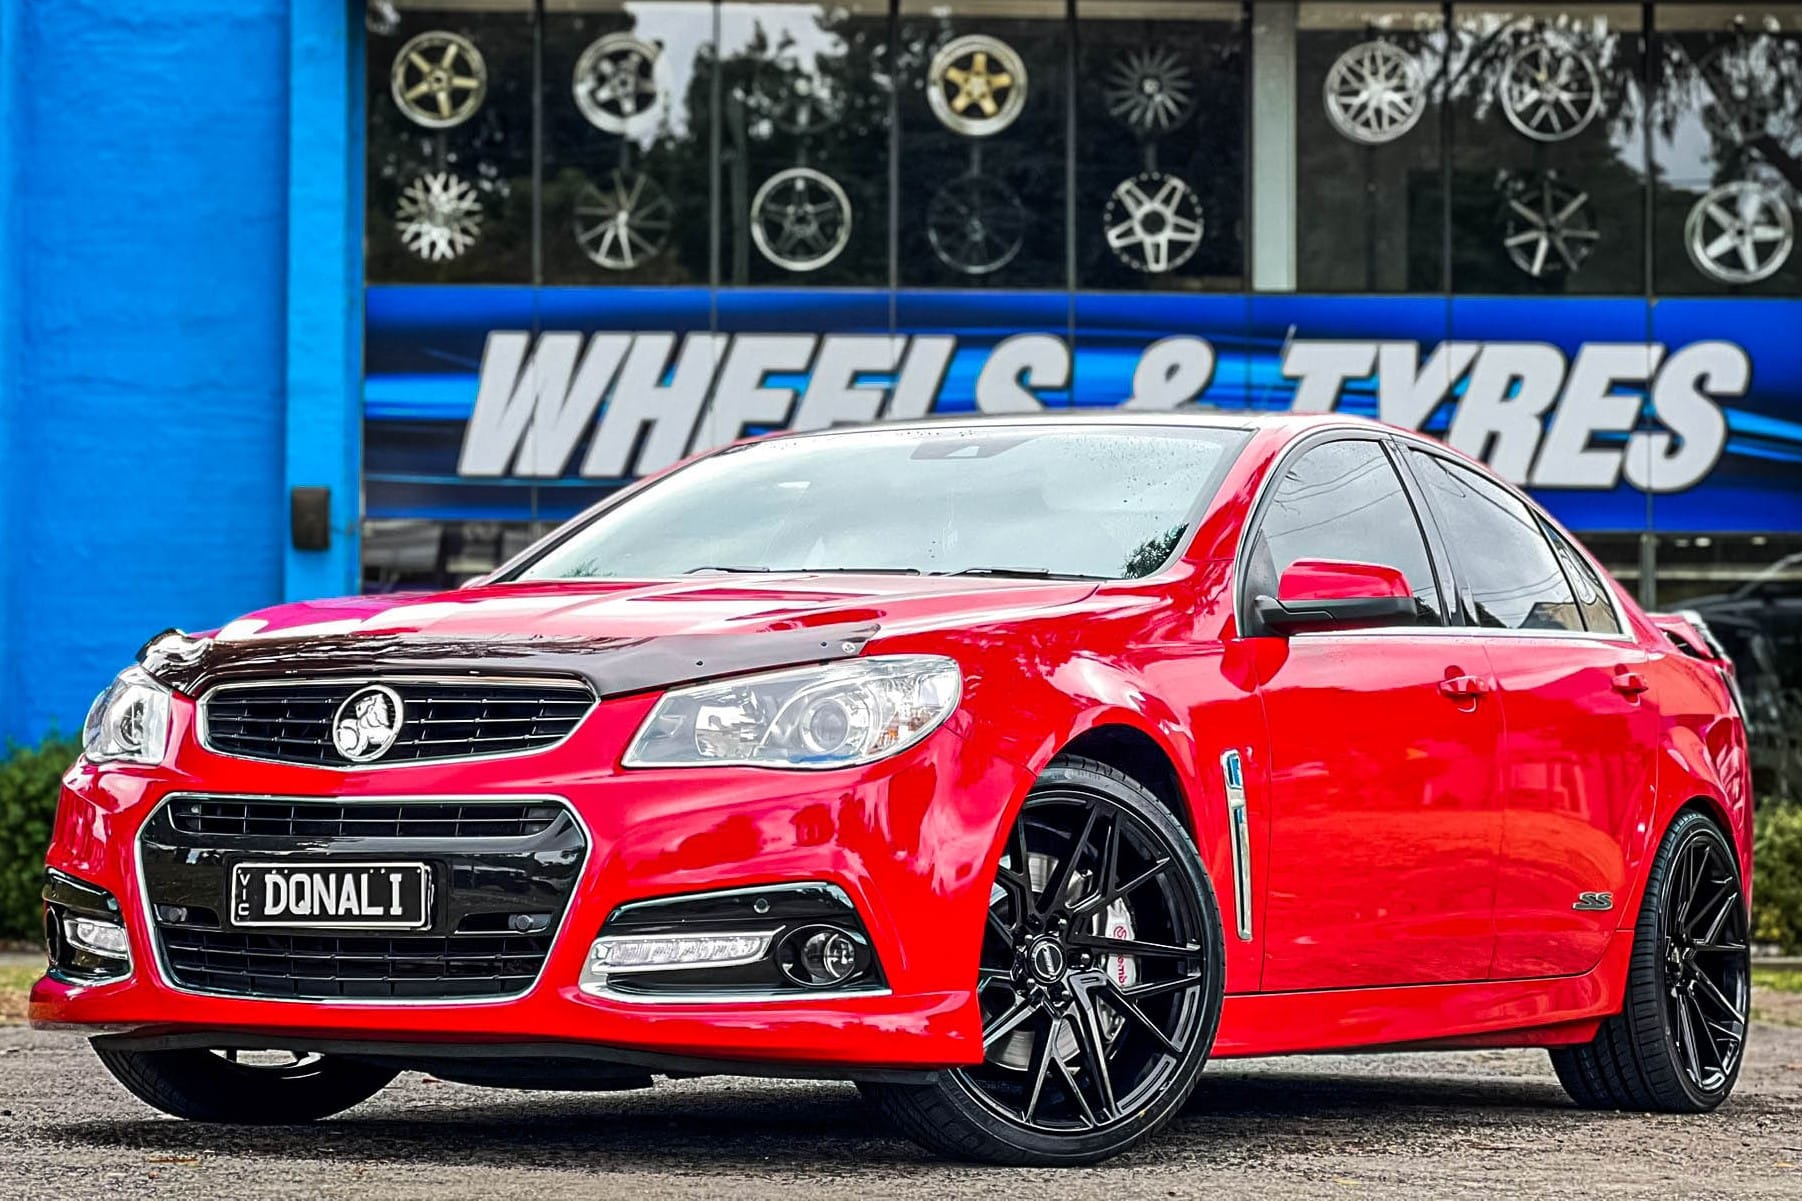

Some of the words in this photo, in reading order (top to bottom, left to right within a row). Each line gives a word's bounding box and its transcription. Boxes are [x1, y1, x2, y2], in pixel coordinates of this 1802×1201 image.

[457, 331, 1071, 477] WHEELS
[1283, 340, 1752, 492] TYRES
[238, 873, 250, 916] VIC
[1572, 891, 1614, 911] SS
